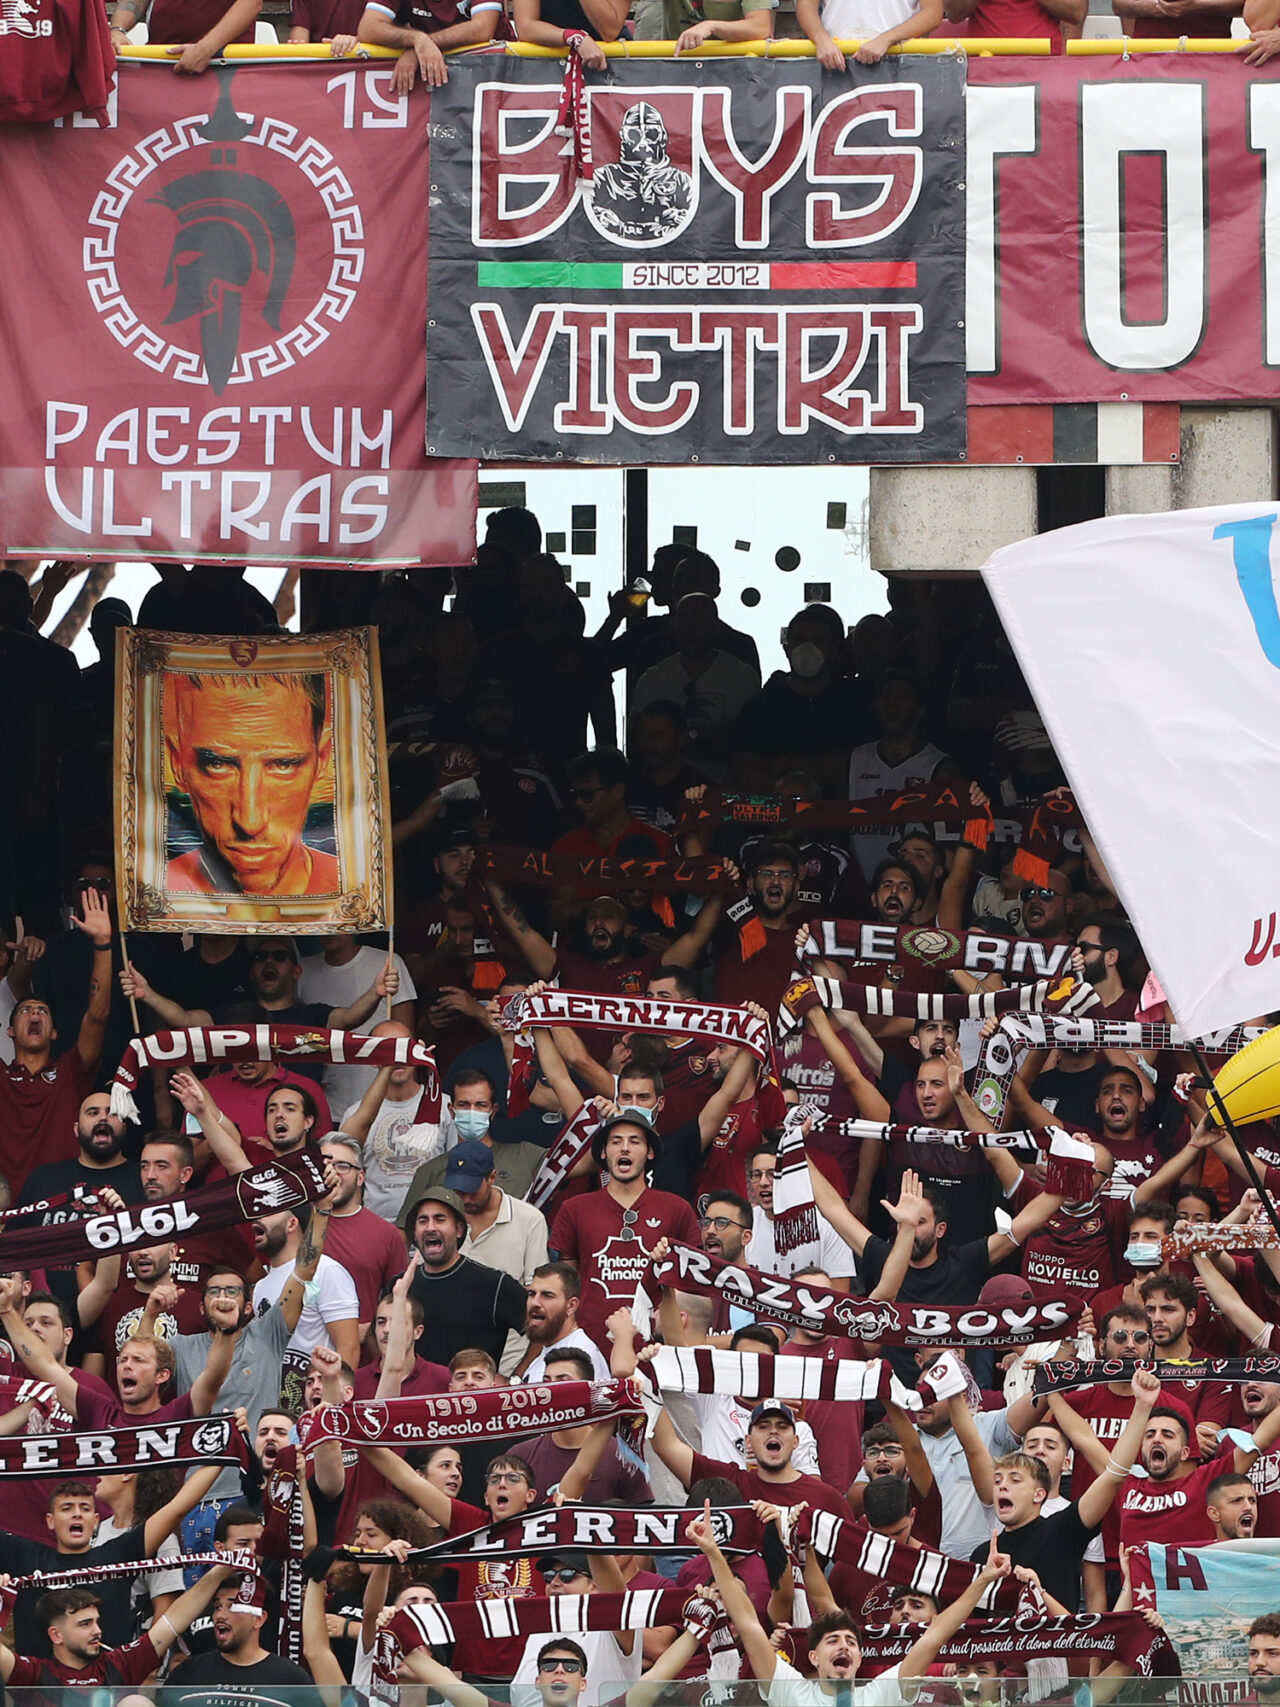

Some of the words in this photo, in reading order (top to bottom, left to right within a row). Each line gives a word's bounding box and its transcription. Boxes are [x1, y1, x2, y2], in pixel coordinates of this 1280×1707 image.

[471, 82, 924, 249] BOYS
[633, 265, 699, 287] SINCE
[707, 265, 760, 287] 2012
[470, 303, 924, 435] VIETRI
[85, 1200, 200, 1250] 1919
[597, 1254, 649, 1269] Antonio
[1027, 1261, 1100, 1283] NOVIELLO
[722, 1290, 823, 1331] ULTRAS
[903, 1332, 1034, 1346] SALERNO
[907, 1300, 1070, 1337] BOYS
[425, 1396, 477, 1417] 1919
[498, 1387, 552, 1411] 2019
[393, 1424, 424, 1439] Un
[426, 1418, 482, 1438] Secolo
[485, 1414, 504, 1432] di
[506, 1407, 586, 1430] Passione
[1121, 1489, 1188, 1511] SALERNO
[969, 1636, 1014, 1659] possiede
[1016, 1633, 1025, 1651] il
[1025, 1632, 1052, 1650] dono
